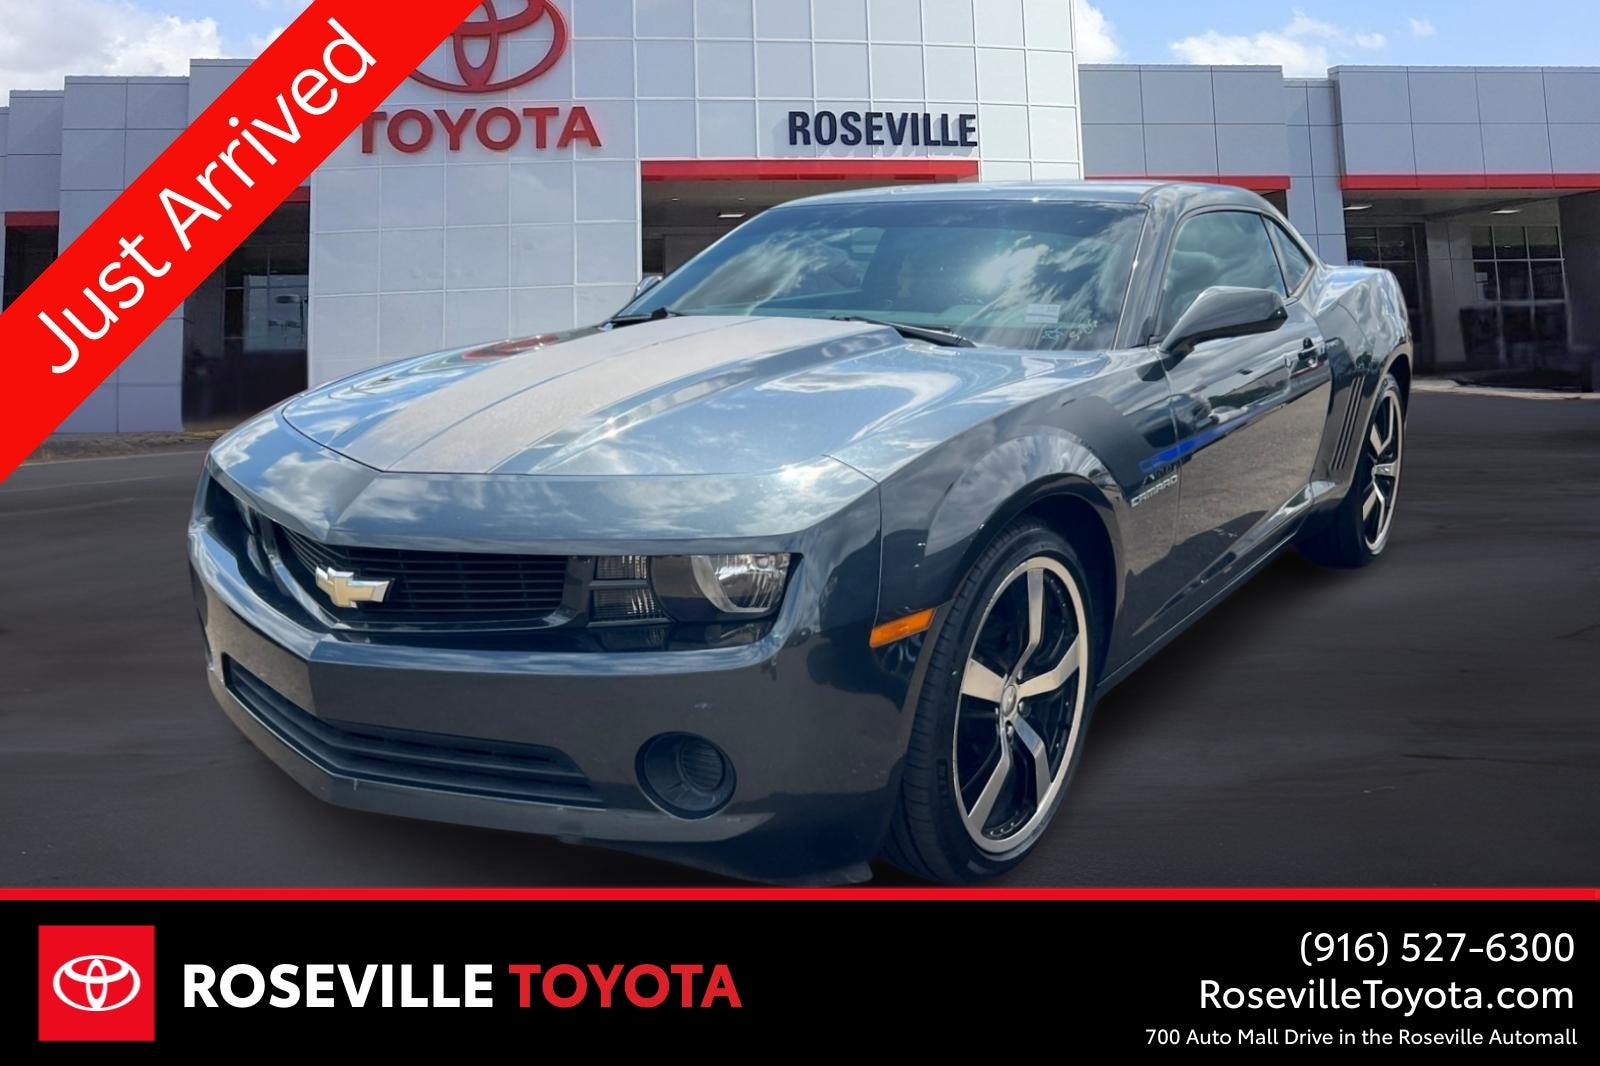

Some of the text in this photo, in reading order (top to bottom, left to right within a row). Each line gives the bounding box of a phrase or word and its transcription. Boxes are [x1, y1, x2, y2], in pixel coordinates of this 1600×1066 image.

[361, 106, 602, 154] TOYOTA
[788, 110, 978, 147] ROSEVILLE
[1130, 474, 1178, 508] CAMARO
